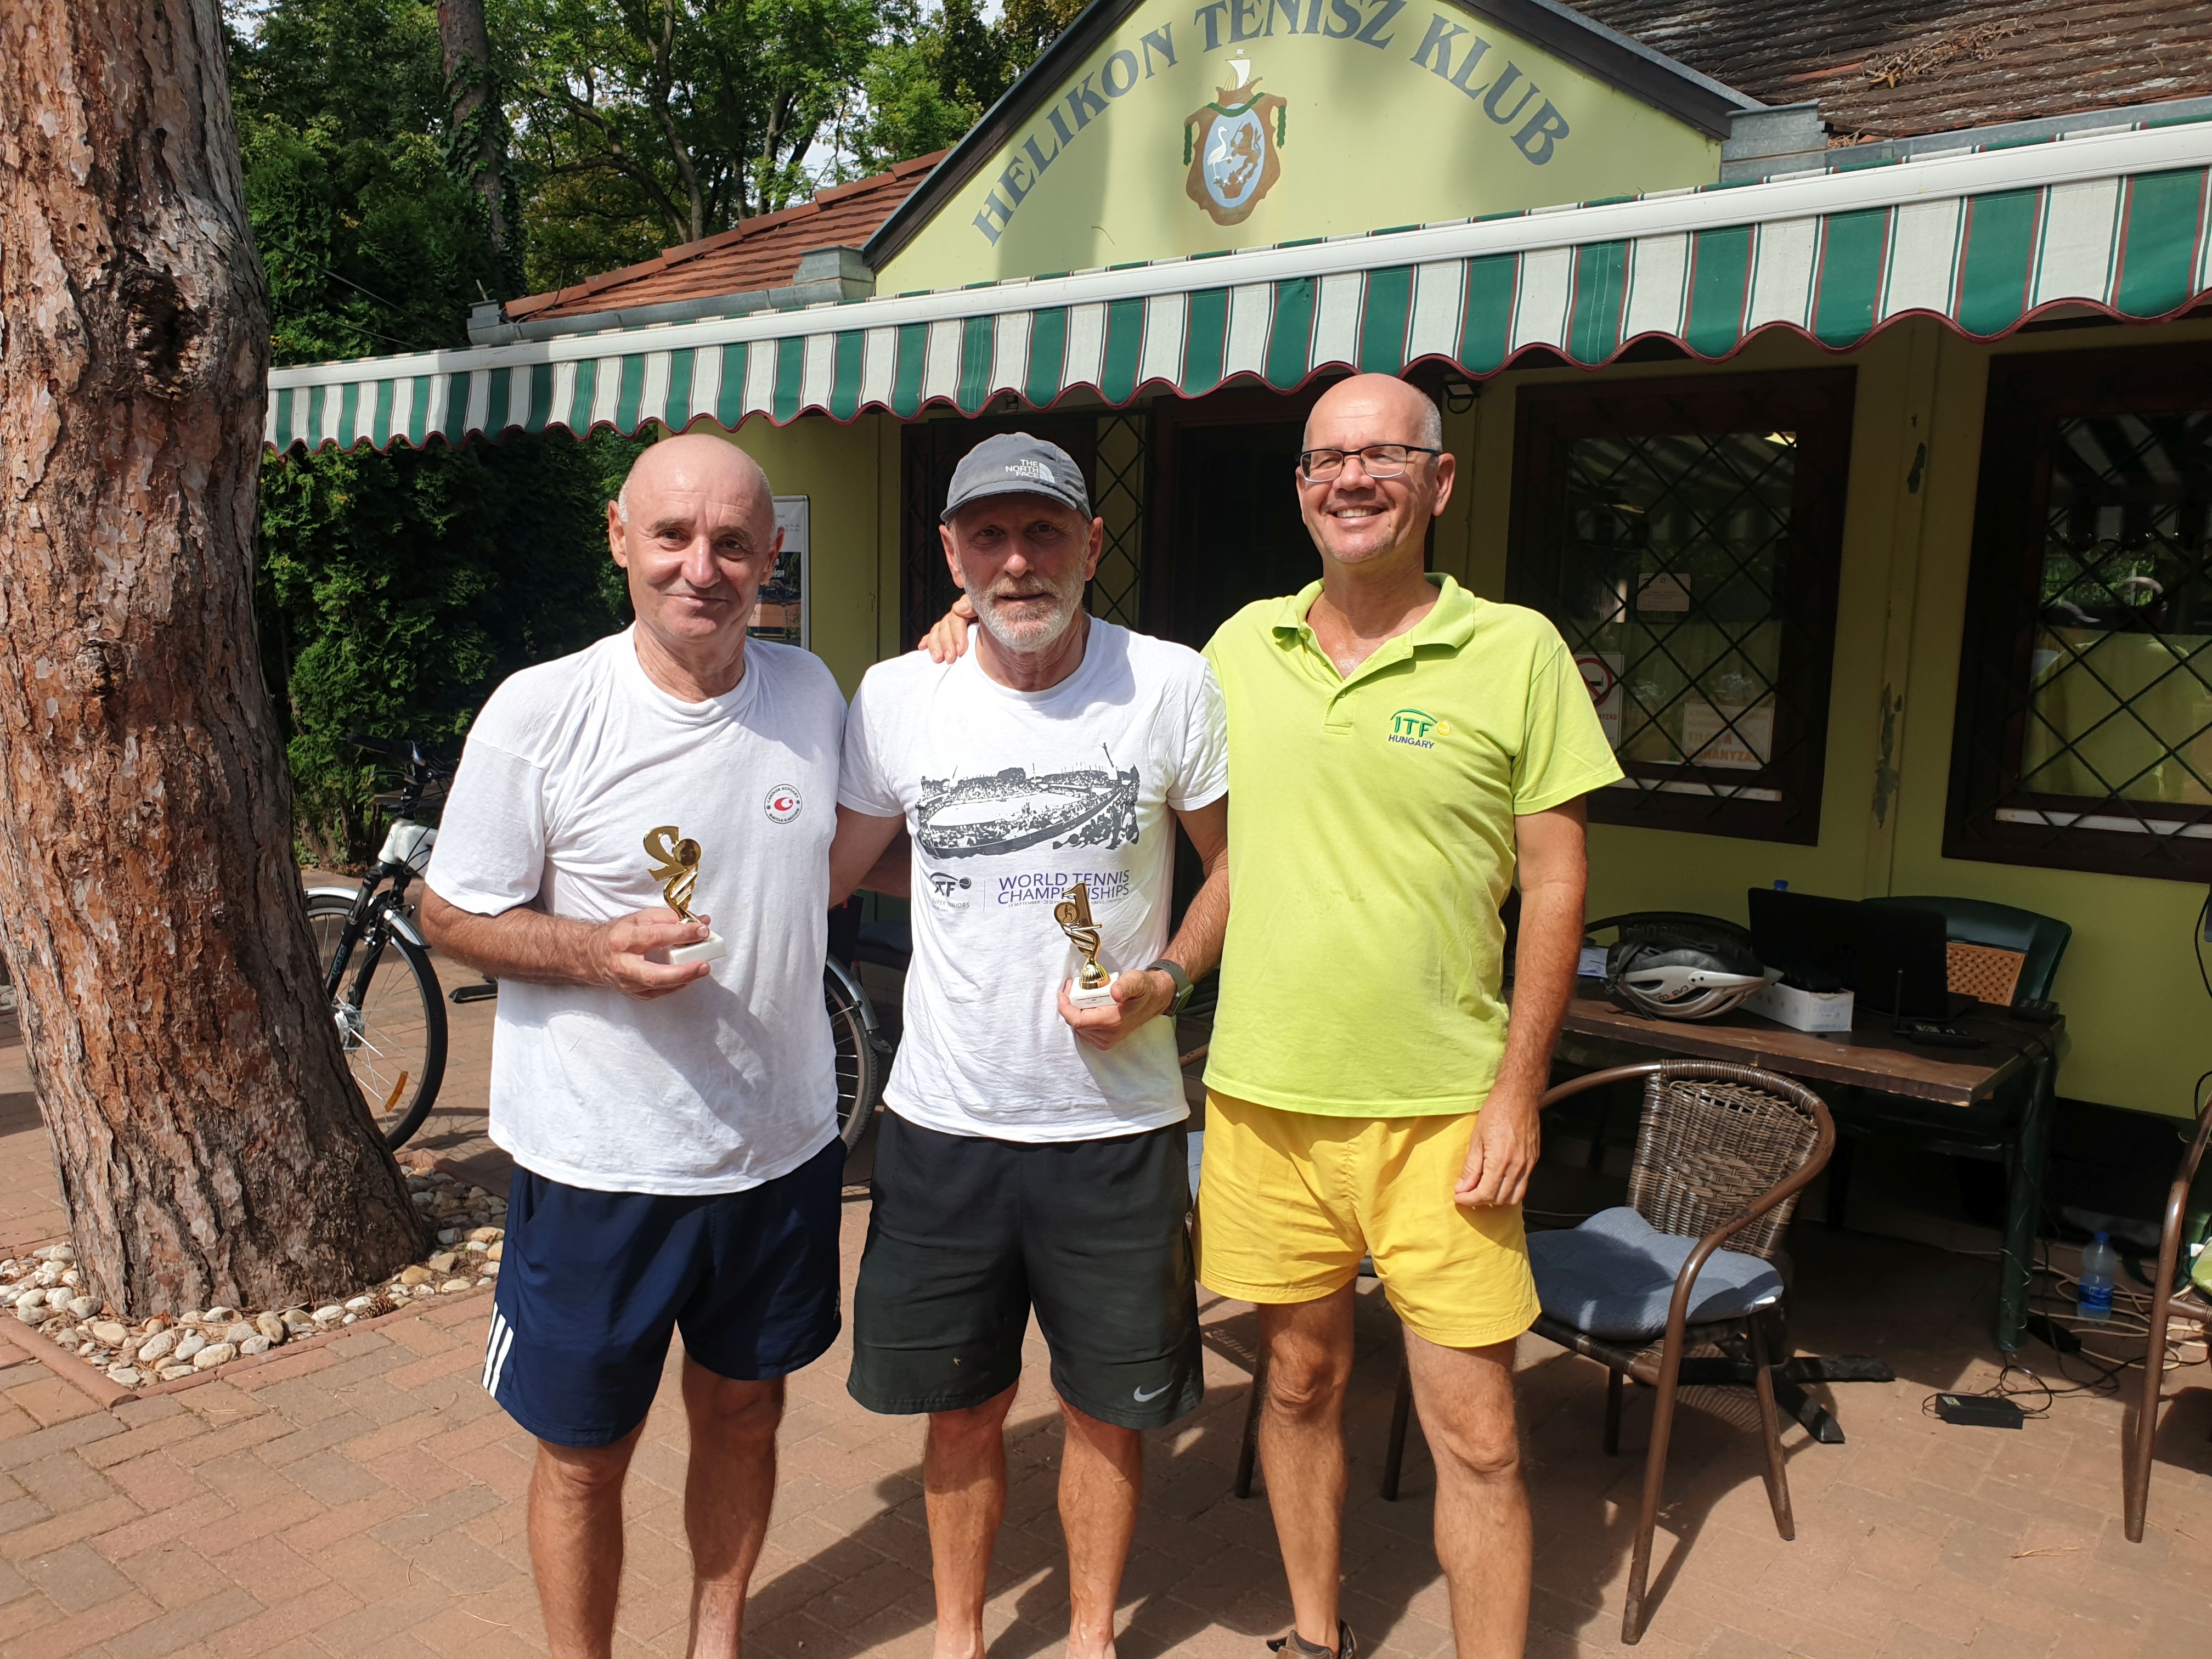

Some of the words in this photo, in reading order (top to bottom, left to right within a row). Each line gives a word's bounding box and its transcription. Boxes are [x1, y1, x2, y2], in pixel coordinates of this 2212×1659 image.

[972, 21, 1178, 248] HELIKON
[1194, 0, 1408, 50] TENISZ
[1410, 13, 1571, 166] KLUB
[1005, 465, 1039, 473] NORTH
[1394, 716, 1434, 738] ITF
[1388, 733, 1435, 749] HUNGARY
[999, 872, 1068, 890] WORLD
[1073, 870, 1130, 886] TENNIS
[932, 898, 946, 906] SUPER
[998, 883, 1129, 904] CHAMPISHIPS
